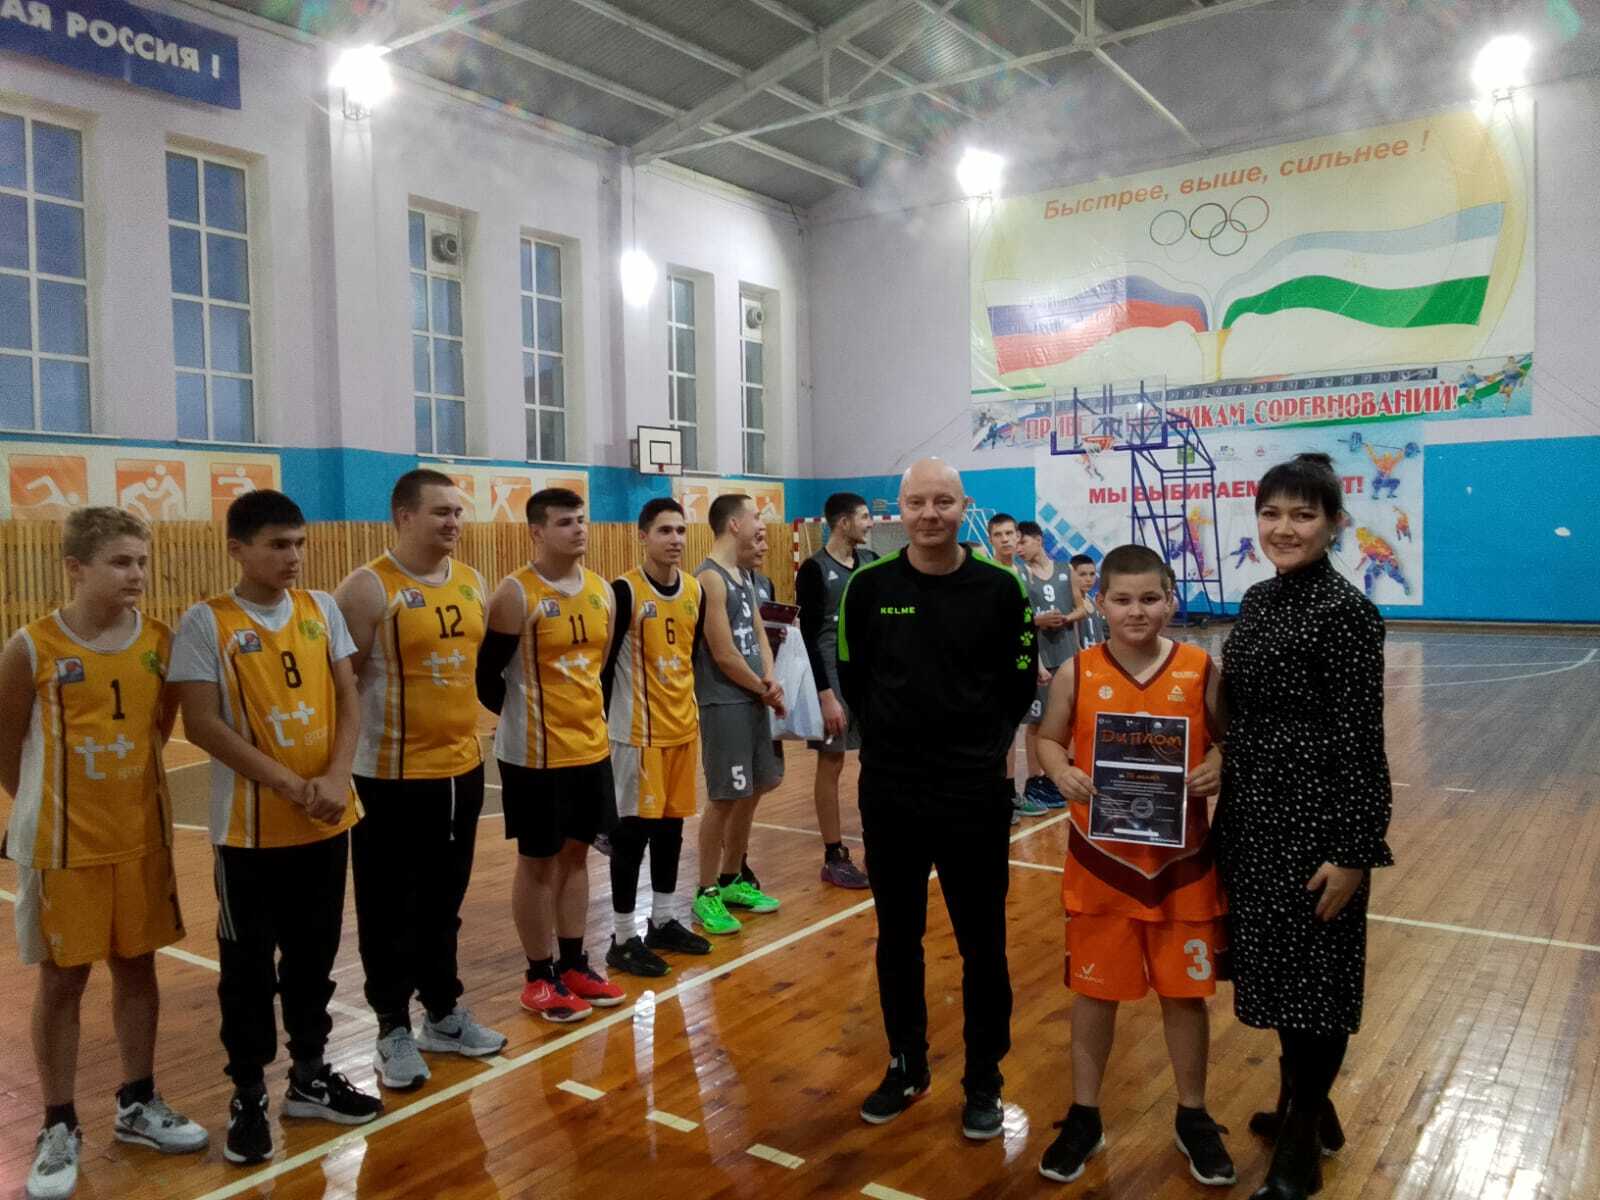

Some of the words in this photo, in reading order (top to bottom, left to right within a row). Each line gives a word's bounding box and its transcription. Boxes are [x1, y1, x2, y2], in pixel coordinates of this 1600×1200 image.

[67, 11, 200, 73] РОССИЯ
[1043, 184, 1169, 219] Быстрее,
[1179, 165, 1269, 195] выше,
[1279, 139, 1409, 177] сильнее
[1254, 380, 1459, 425] СОРЕВНОВАНИЙ!
[1089, 486, 1127, 505] МЫ
[1133, 480, 1260, 502] ВЫБИРАЕМ
[880, 606, 916, 615] KELME
[1043, 584, 1056, 602] 9
[435, 604, 464, 639] 12
[569, 614, 588, 644] 11
[665, 618, 676, 645] 6
[281, 651, 302, 689] 8
[111, 679, 126, 720] 1
[731, 765, 747, 791] 5
[1184, 939, 1211, 981] 3
